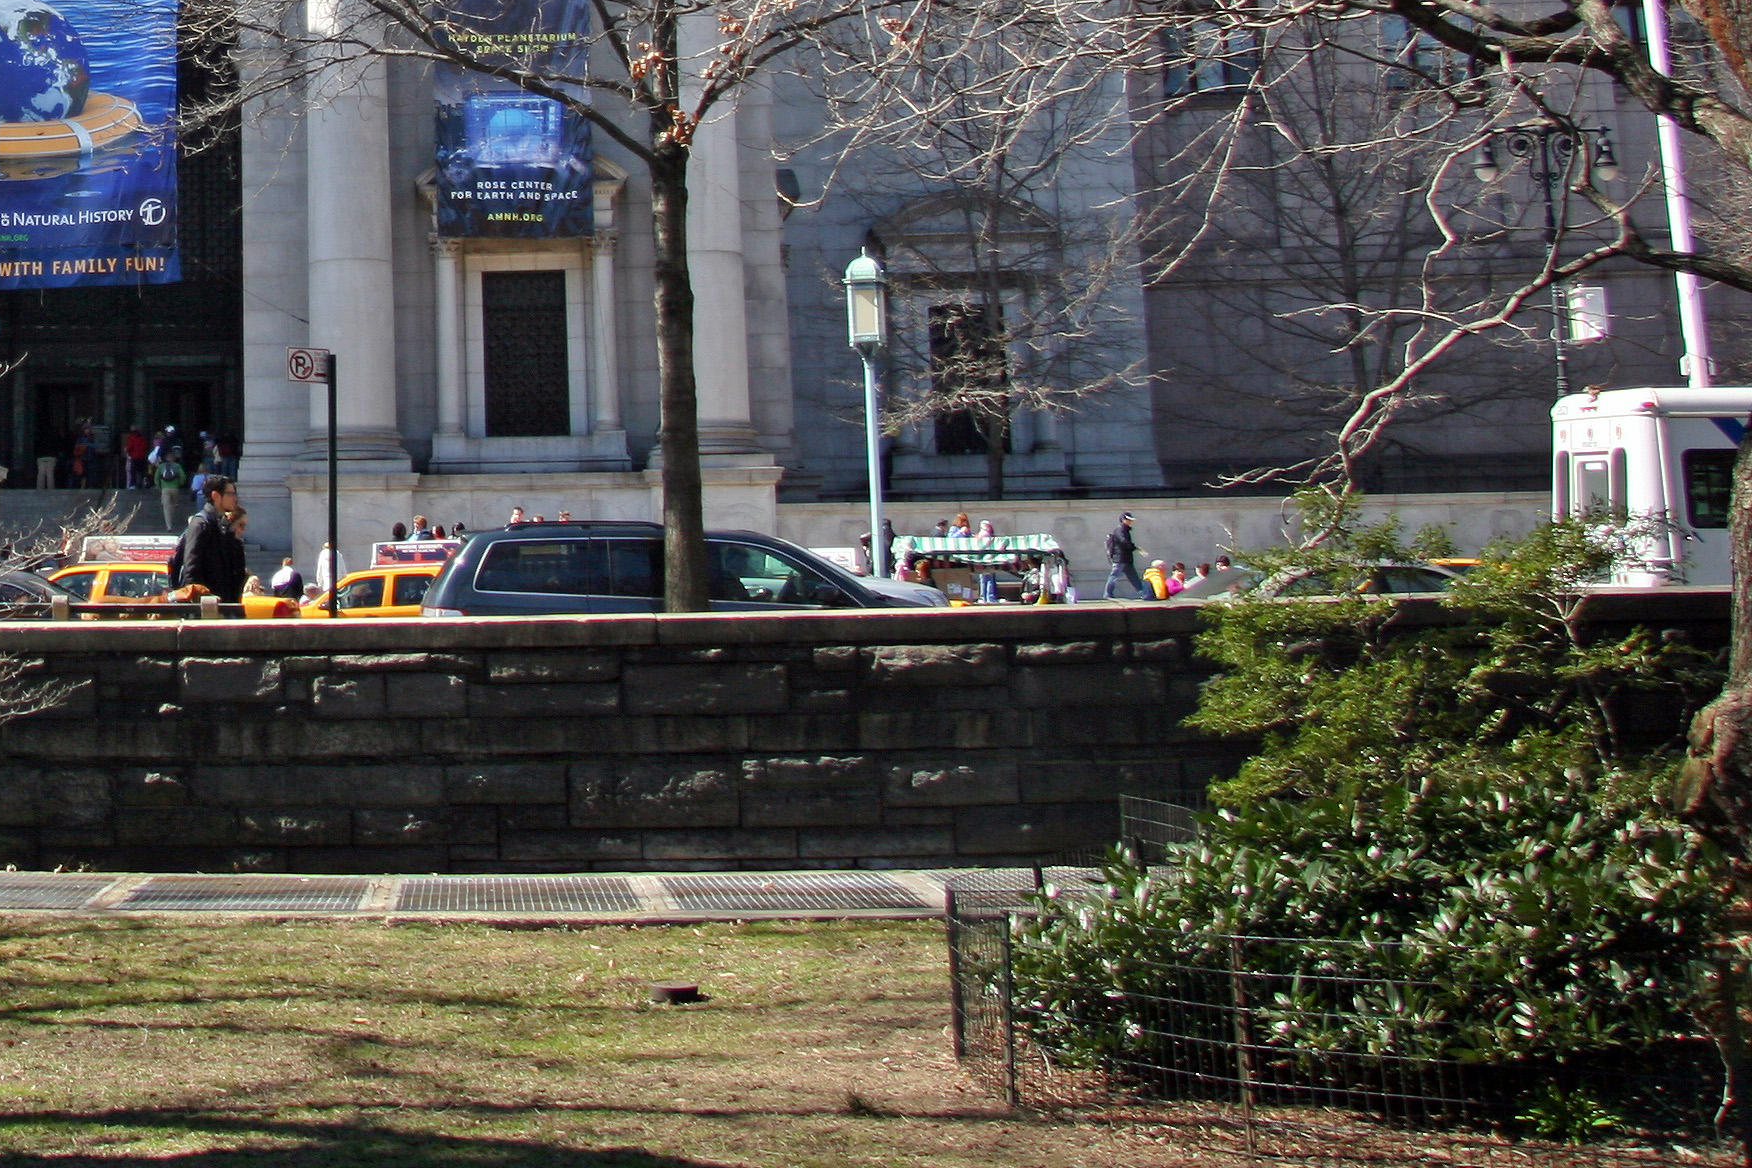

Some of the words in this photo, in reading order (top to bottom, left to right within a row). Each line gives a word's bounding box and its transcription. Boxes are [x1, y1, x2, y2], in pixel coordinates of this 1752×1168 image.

[497, 32, 577, 43] PLANETARIUM
[476, 181, 507, 190] ROSE
[510, 181, 553, 190] CENTER
[450, 191, 473, 200] FOR
[476, 191, 514, 200] EARTH
[518, 191, 541, 201] AND
[544, 190, 578, 202] SPACE
[13, 211, 76, 227] NATURAL
[78, 208, 135, 225] HISTORY
[0, 261, 43, 276] WITH
[52, 257, 117, 275] FAMILY
[125, 256, 165, 273] FUN!
